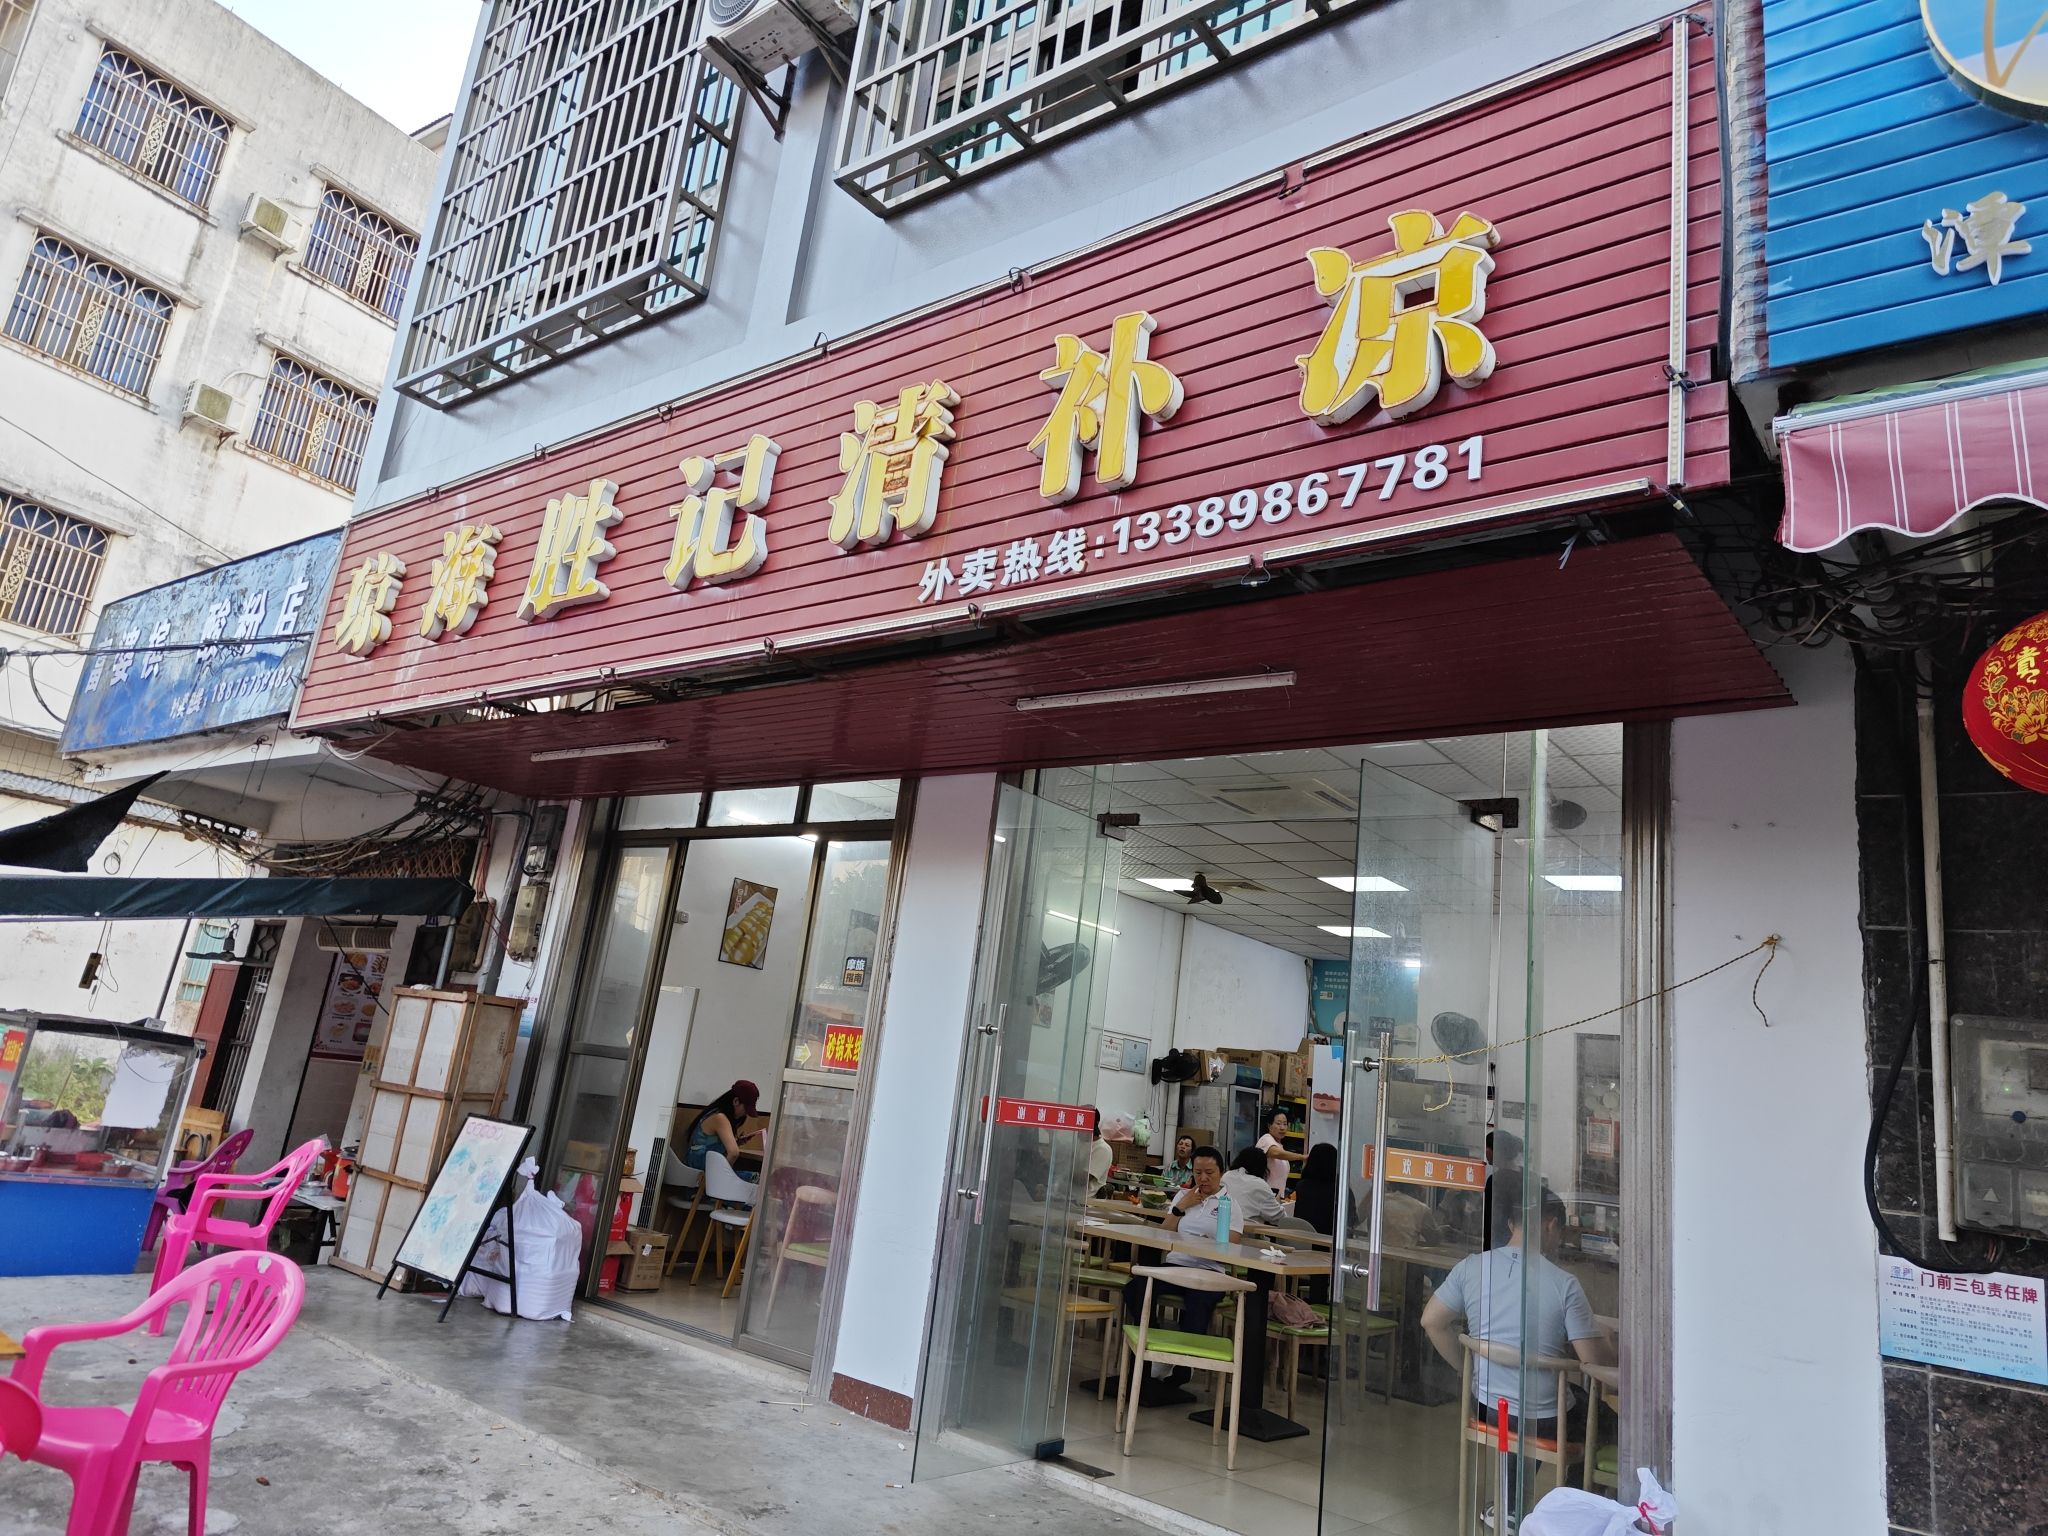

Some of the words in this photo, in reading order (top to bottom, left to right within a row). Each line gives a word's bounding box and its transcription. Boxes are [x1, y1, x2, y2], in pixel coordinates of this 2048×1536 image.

[335, 209, 1500, 657] 琼海胜记清补凉
[918, 434, 1485, 603] 外卖热线:13389867781
[1402, 1158, 1474, 1183] 欢迎光临
[1920, 1271, 2039, 1304] 门前三包责任牌
